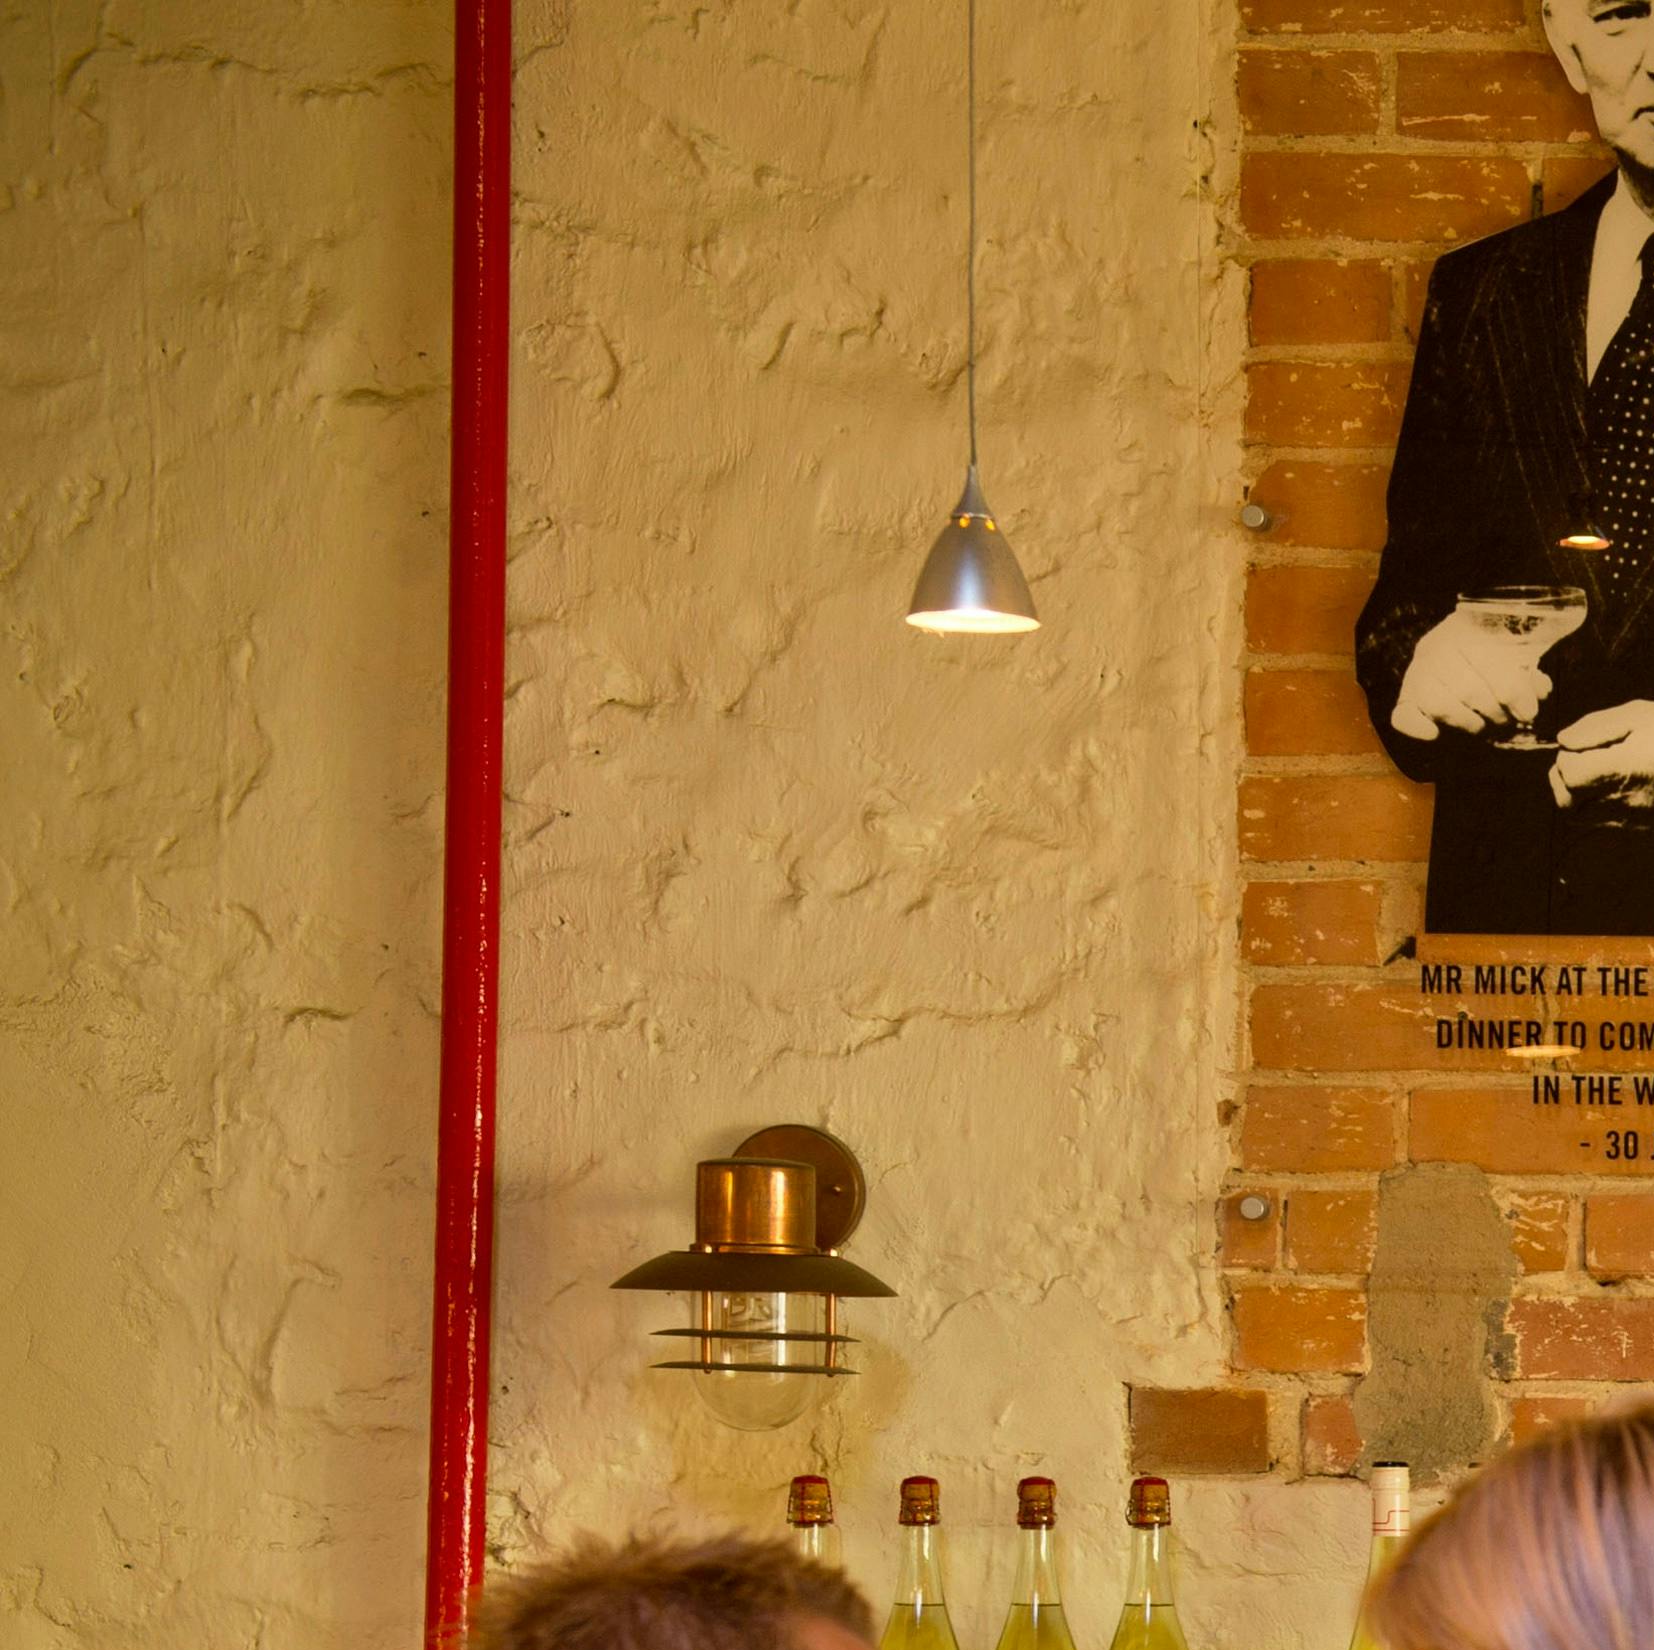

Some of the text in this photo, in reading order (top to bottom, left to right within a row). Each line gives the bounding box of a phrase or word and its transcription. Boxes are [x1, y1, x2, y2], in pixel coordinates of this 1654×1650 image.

[1421, 964, 1463, 995] MR
[1474, 964, 1547, 996] MICK
[1555, 966, 1587, 996] AT
[1597, 967, 1649, 997] THE
[1436, 1019, 1543, 1051] DINNER
[1553, 1020, 1587, 1050] TO
[1533, 1075, 1560, 1105] IN
[1571, 1074, 1623, 1106] THE
[1605, 1130, 1639, 1160] 30
